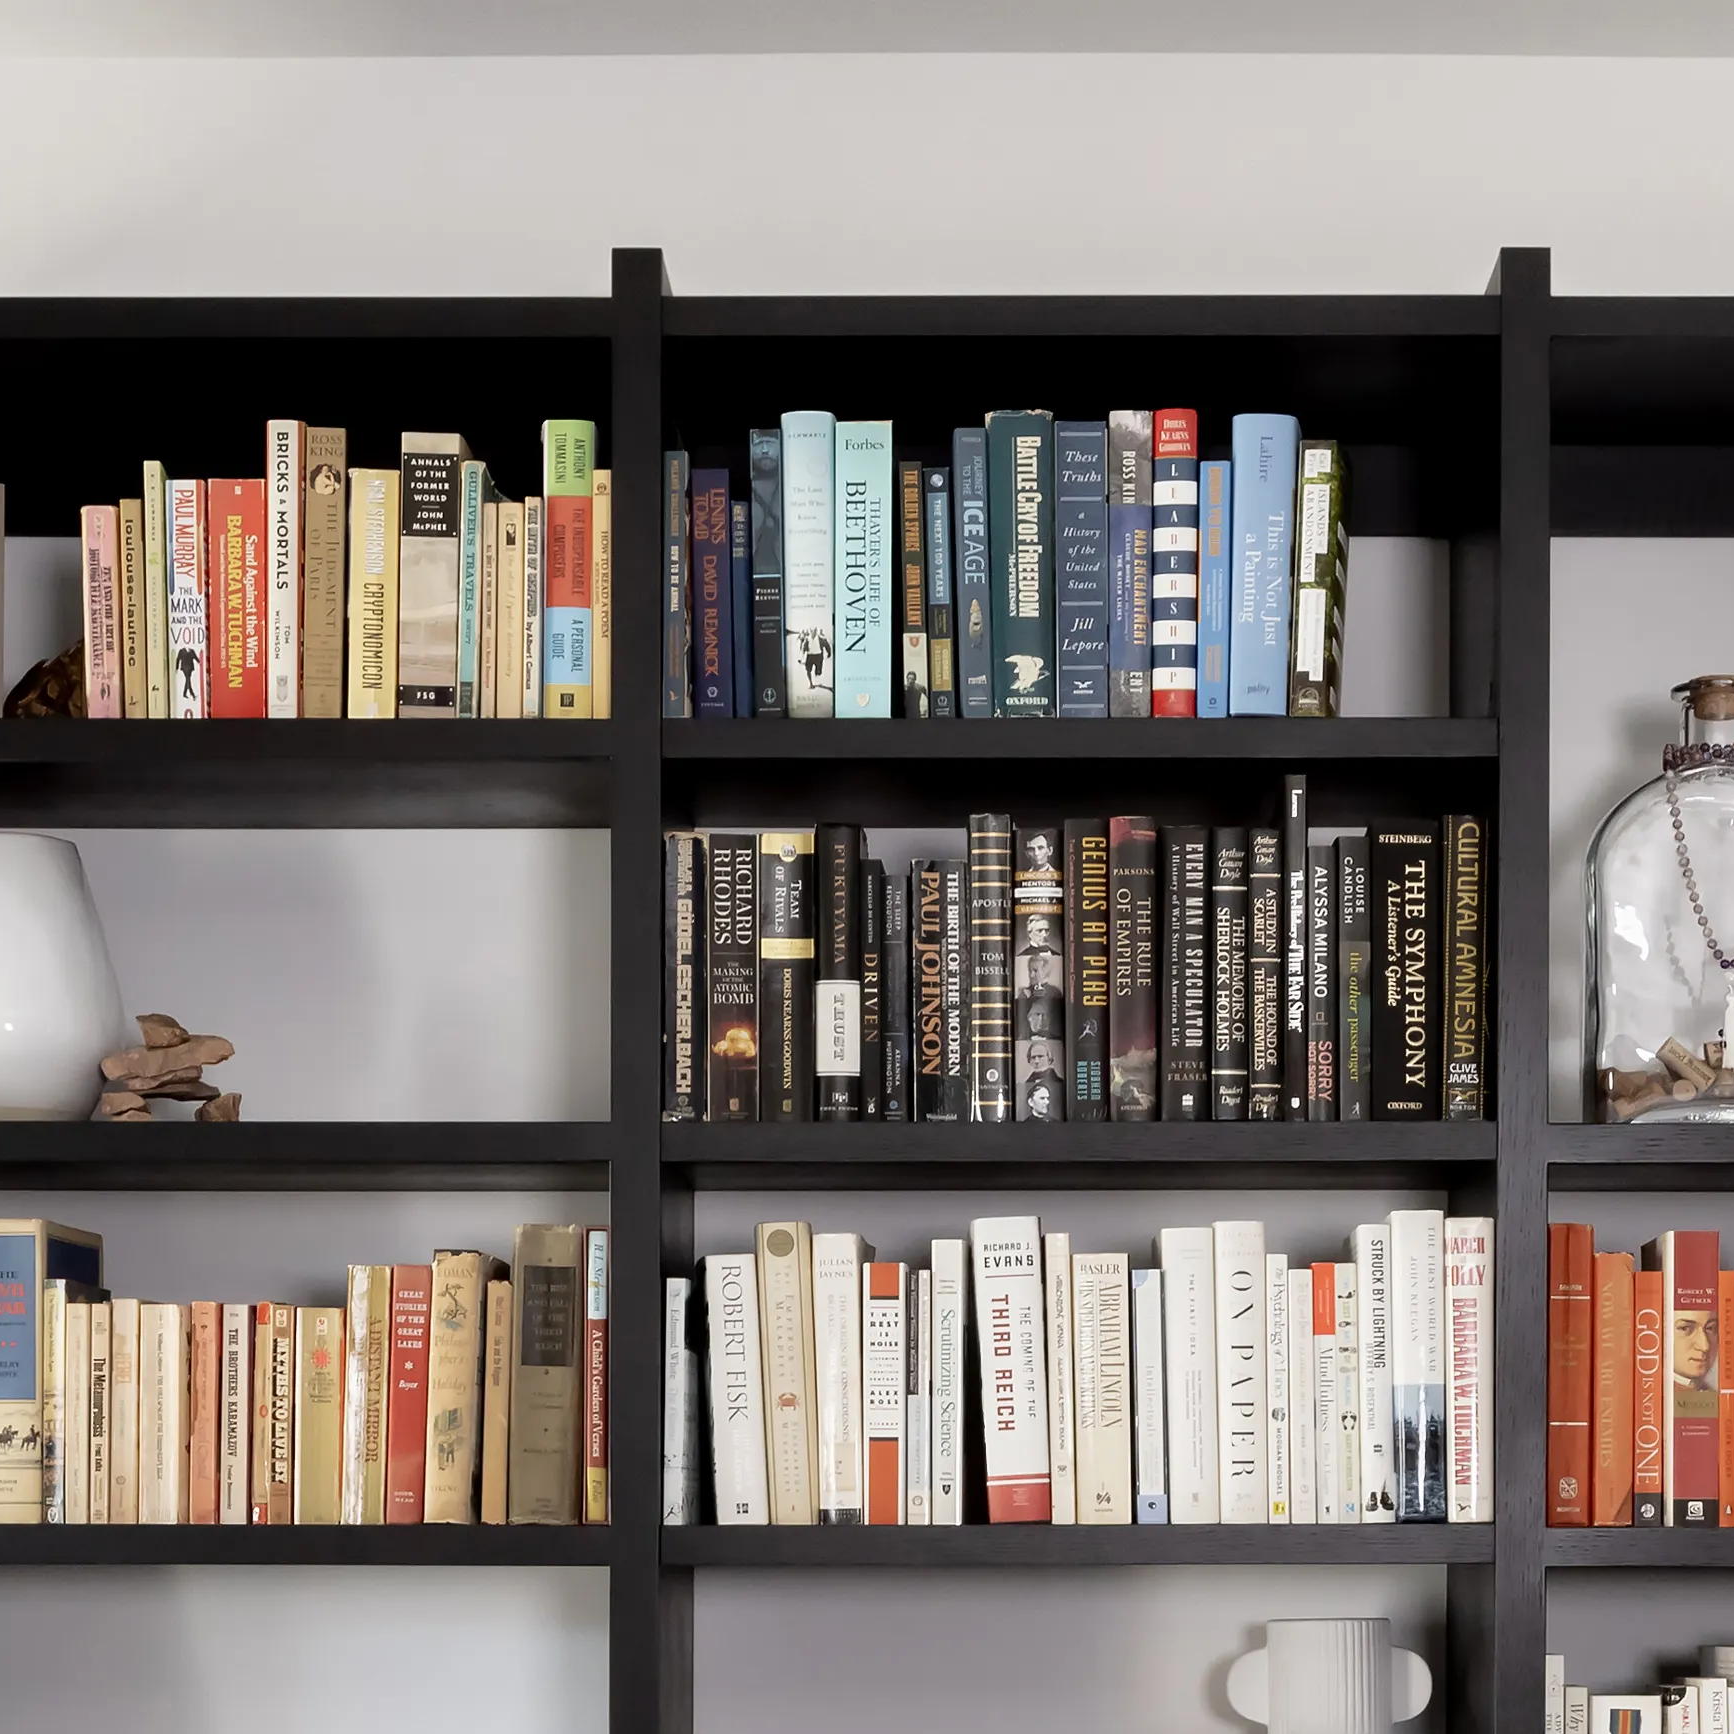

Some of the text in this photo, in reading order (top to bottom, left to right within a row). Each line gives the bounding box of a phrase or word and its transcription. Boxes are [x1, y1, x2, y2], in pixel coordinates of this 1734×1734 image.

[276, 432, 289, 493] BRICKS
[554, 433, 567, 483] TOMMASINI
[574, 438, 586, 479] ANTHONY
[845, 439, 884, 450] Forbes
[1065, 451, 1098, 462] These
[411, 482, 449, 490] FORMER
[414, 494, 447, 502] WORLD
[1062, 471, 1102, 483] Truths
[174, 490, 195, 578] PAUL MURRAY
[417, 511, 443, 519] JOHN
[963, 500, 985, 584] ICE AGE
[1017, 436, 1042, 618] BATTLE CRY OF FREEDOM
[277, 511, 288, 590] MORTALS
[844, 480, 867, 654] BEETHOVEN
[869, 498, 881, 627] THAYER'S LIFE OF
[1240, 533, 1261, 623] a Painting
[1260, 511, 1284, 646] This is Not Just
[171, 598, 202, 613] MARK
[171, 616, 202, 624] AND THE
[179, 587, 193, 595] THE
[243, 535, 258, 668] Sand Against the Wind
[171, 627, 204, 644] VOID
[362, 582, 384, 689] CRYPTONOMICON
[1062, 639, 1104, 652] Lepore
[1072, 619, 1093, 630] Jill
[1379, 834, 1432, 844] STEINBERG
[714, 848, 731, 945] RHODES
[736, 848, 752, 945] RICHARD
[1344, 856, 1353, 924] CANDLISH
[1355, 867, 1364, 913] LOUISE
[1388, 880, 1400, 893] A
[1116, 888, 1131, 996] OF EMPIRES
[1136, 897, 1151, 987] THE RULE
[1314, 866, 1328, 998] ALYSSA MILANO
[1453, 822, 1479, 1058] CULTURAL AMNESIA
[917, 871, 941, 1075] PAUL JOHNSON
[947, 872, 960, 1076] THE BIRTH OF THE MODERN
[1216, 907, 1229, 1051] SHERLOCK HOLMES
[1385, 966, 1400, 1007] Guide
[1405, 860, 1426, 1087] THE SYMPHONY
[1448, 1073, 1479, 1084] JAMES
[1450, 1063, 1476, 1073] CLIVE
[1387, 1101, 1422, 1110] OXFORD
[984, 1254, 1034, 1268] EVANS
[592, 1330, 601, 1339] A
[721, 1265, 747, 1361] ROBERT
[1371, 1240, 1385, 1368] STRUCK BY LIGHTNING
[227, 1328, 238, 1457] THE BROTHERS KARAMAZOV
[937, 1309, 955, 1457] Scrutinizing Science
[991, 1294, 1015, 1431] THIRD REICH
[592, 1376, 601, 1412] Garden
[592, 1414, 601, 1425] of
[726, 1371, 749, 1422] FISK
[1636, 1308, 1660, 1485] GOD IS NOT ONE
[592, 1425, 601, 1457] Verses
